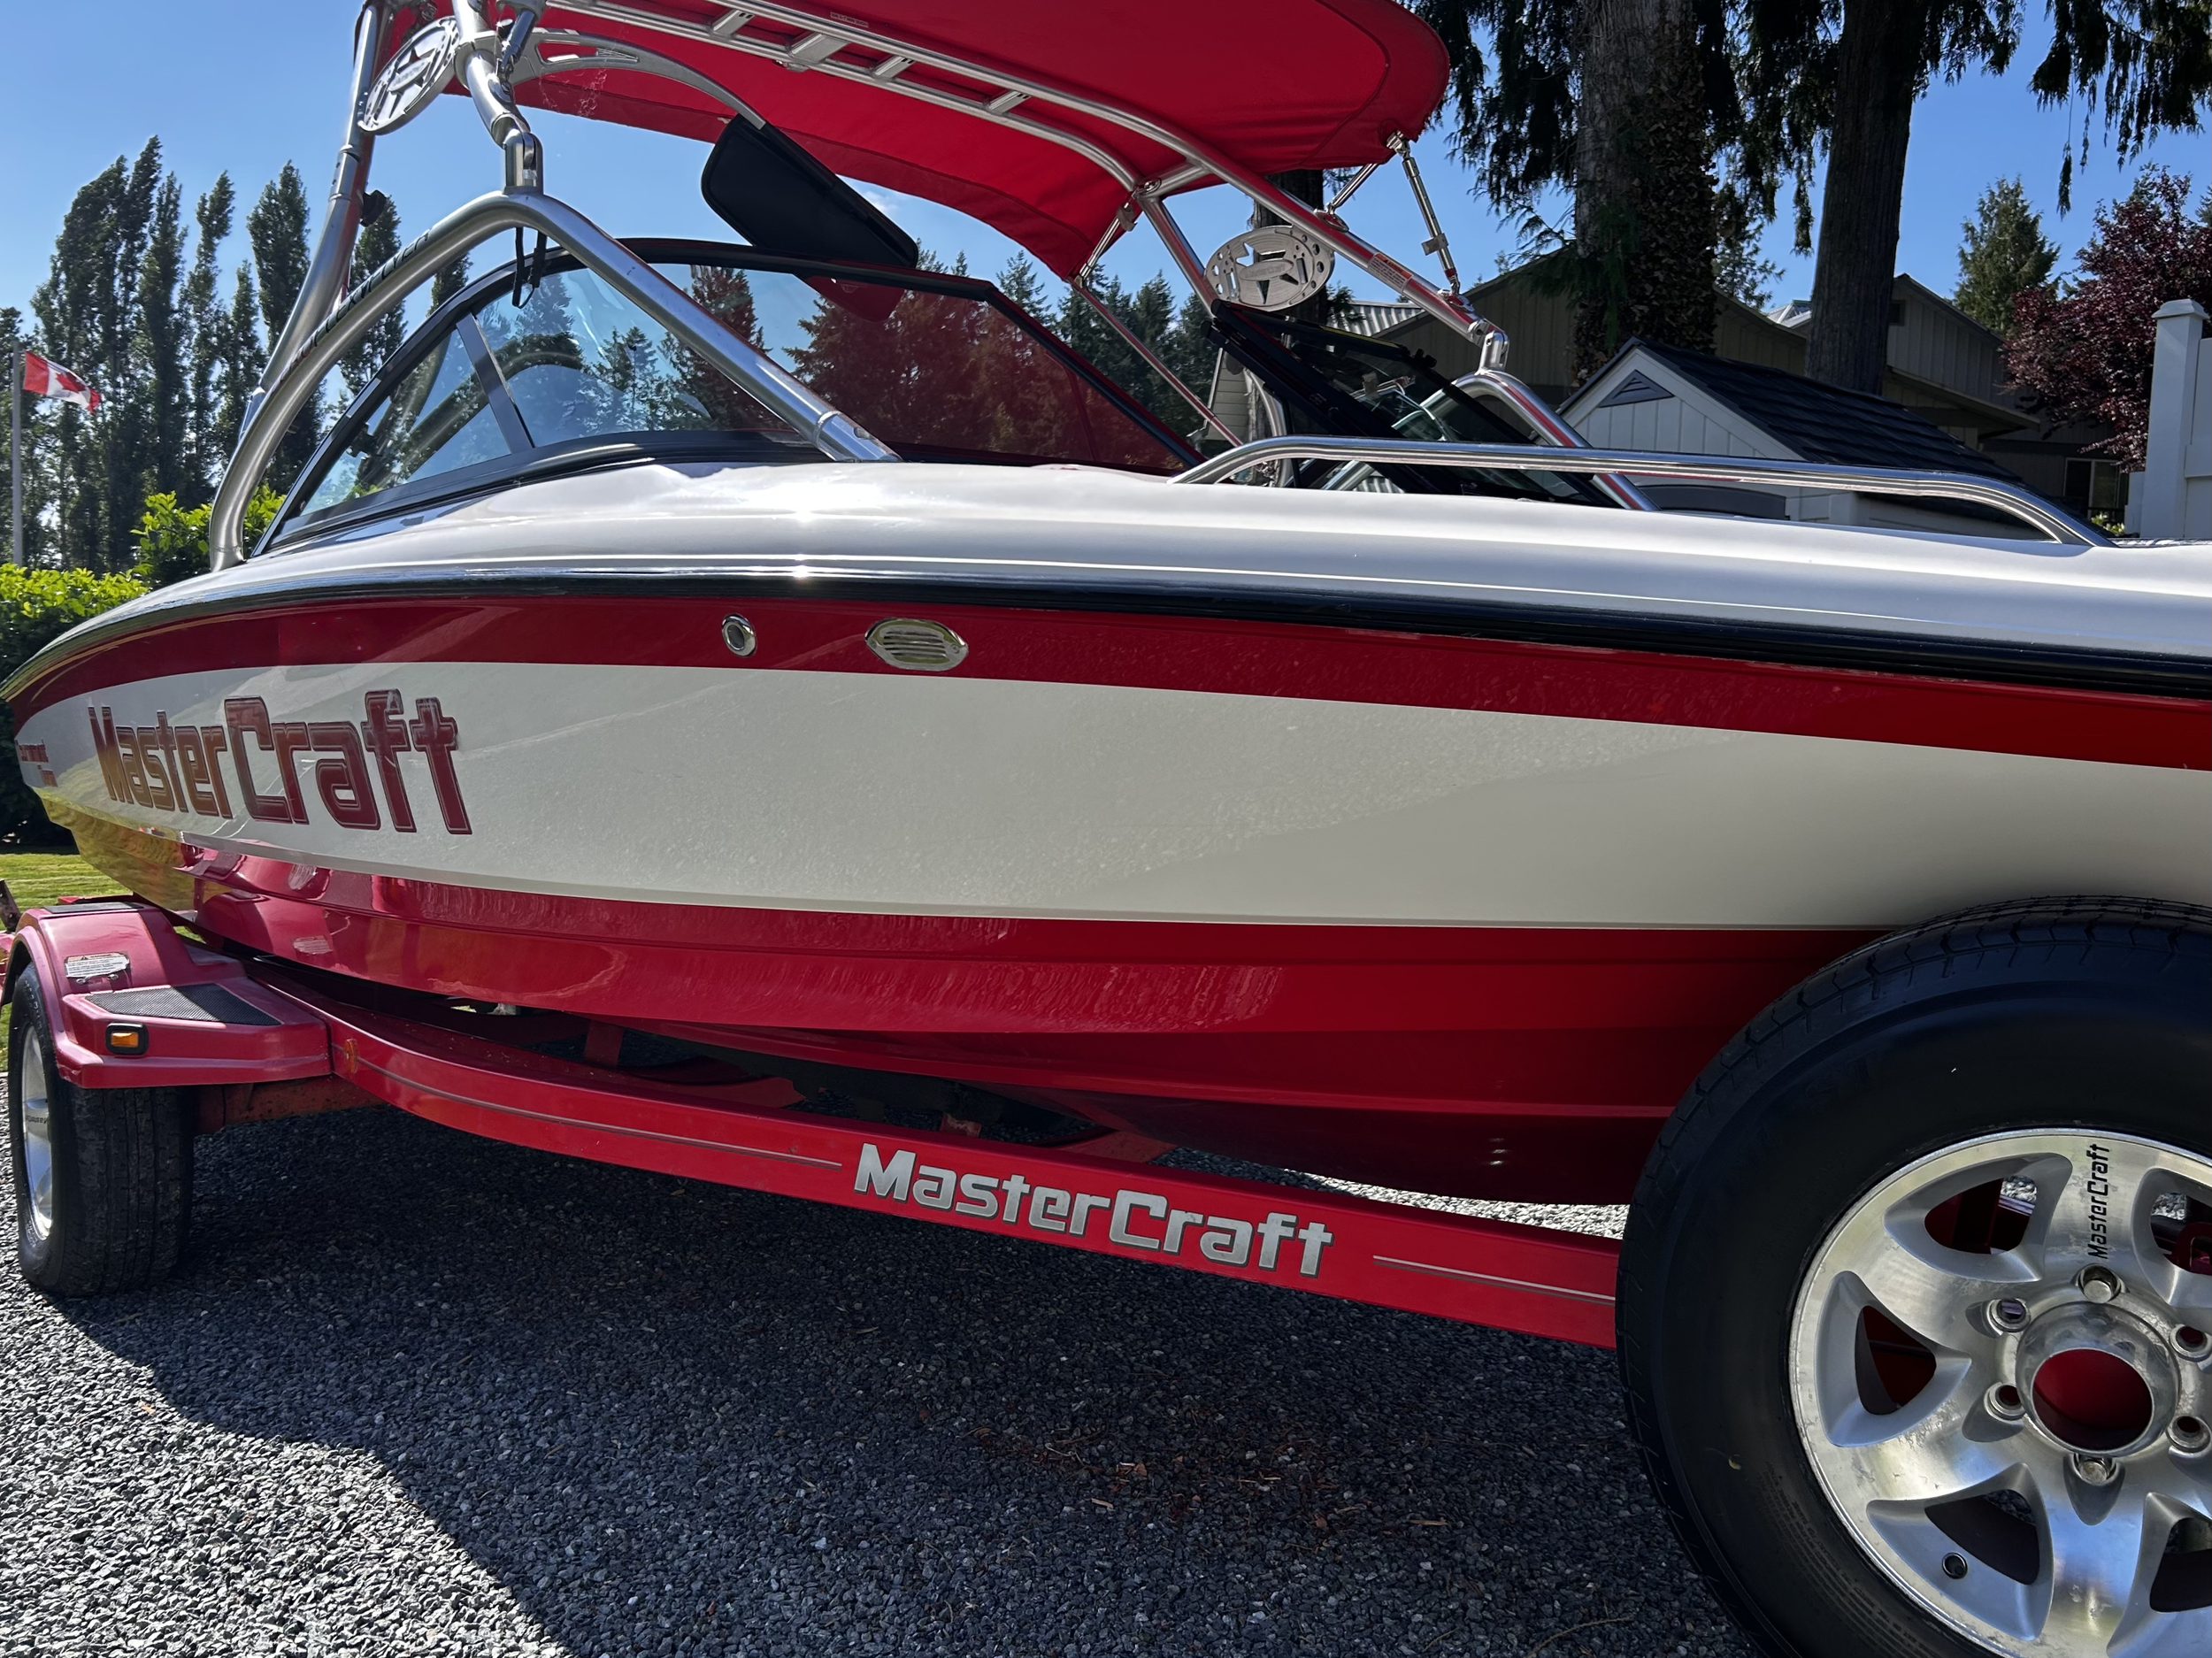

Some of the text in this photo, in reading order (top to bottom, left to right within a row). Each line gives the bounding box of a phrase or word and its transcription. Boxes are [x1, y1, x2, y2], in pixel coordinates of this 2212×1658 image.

[88, 688, 472, 835] MasterCraft
[853, 1142, 1334, 1278] MasterCraft
[2085, 1144, 2110, 1260] MasterCraft
